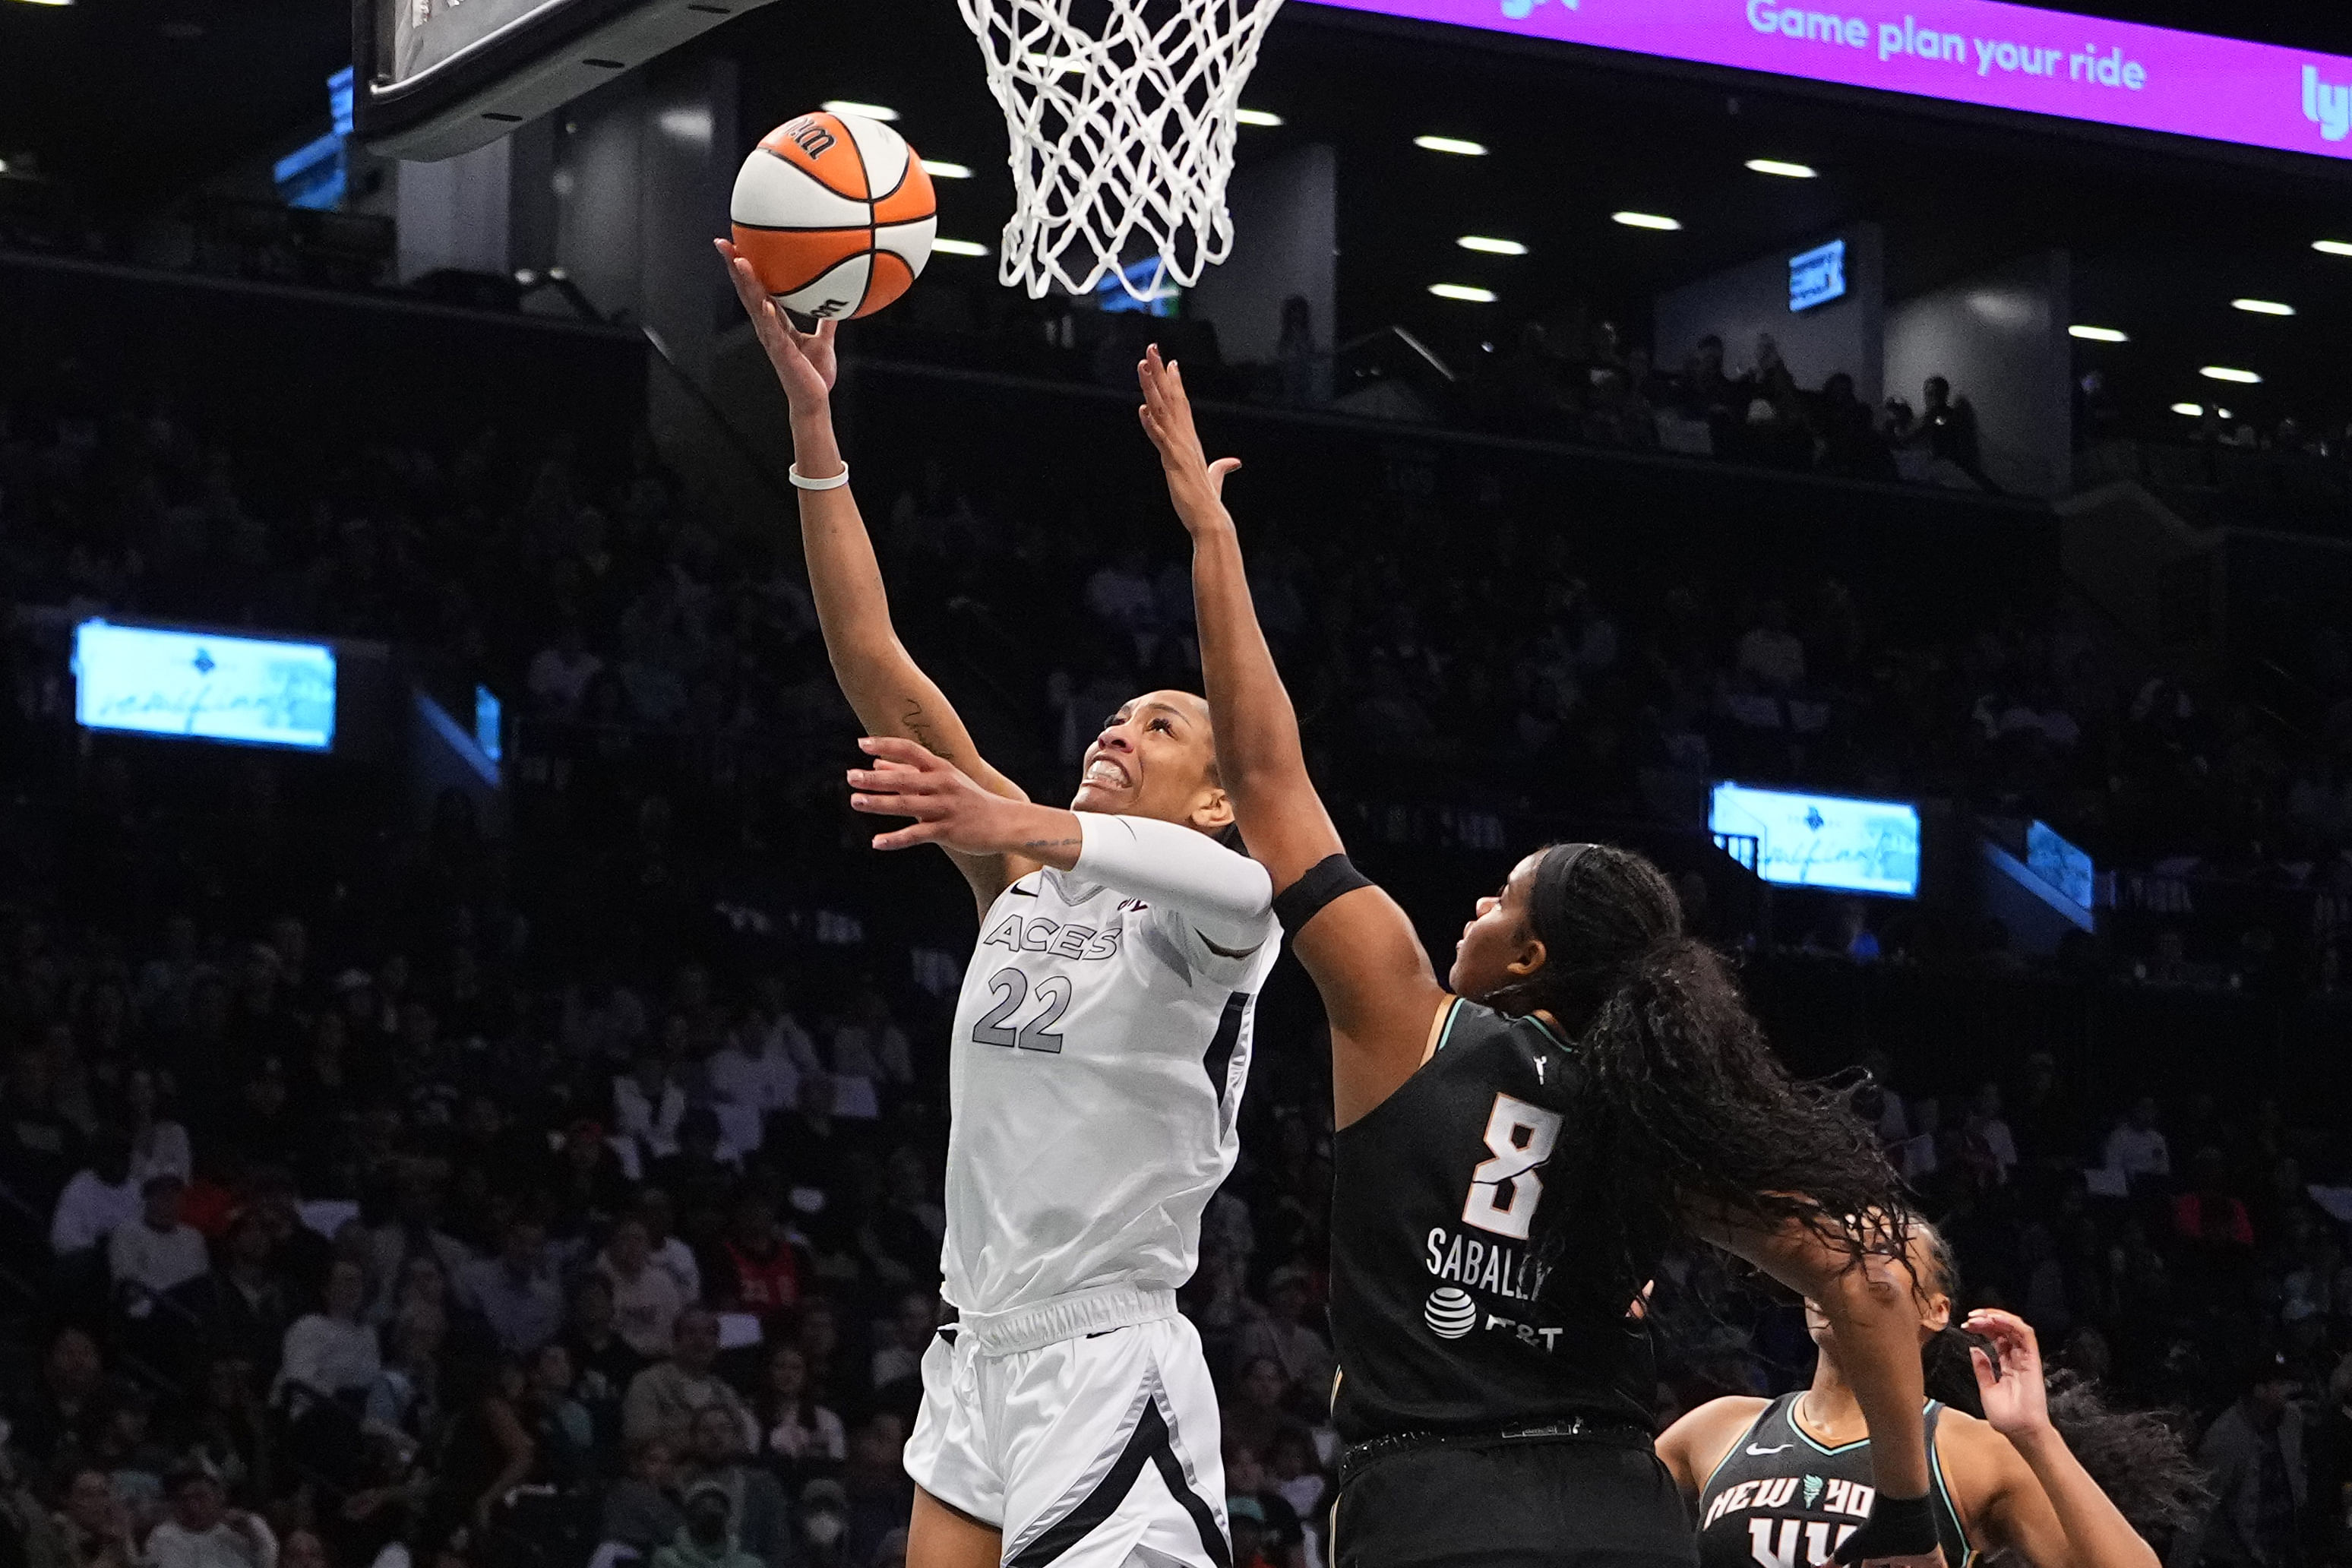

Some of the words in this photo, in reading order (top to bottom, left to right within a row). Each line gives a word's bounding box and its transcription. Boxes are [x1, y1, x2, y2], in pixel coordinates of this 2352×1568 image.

[1747, 0, 1870, 48] Game
[1879, 14, 1968, 63] plan
[1973, 37, 2062, 76] your
[2069, 43, 2147, 90] ride
[2302, 64, 2352, 142] ly
[983, 914, 1123, 960] ACES
[972, 967, 1073, 1054] 22
[1462, 1091, 1565, 1241] 8
[1702, 1477, 1801, 1532] NEW
[1822, 1478, 1876, 1519] YO
